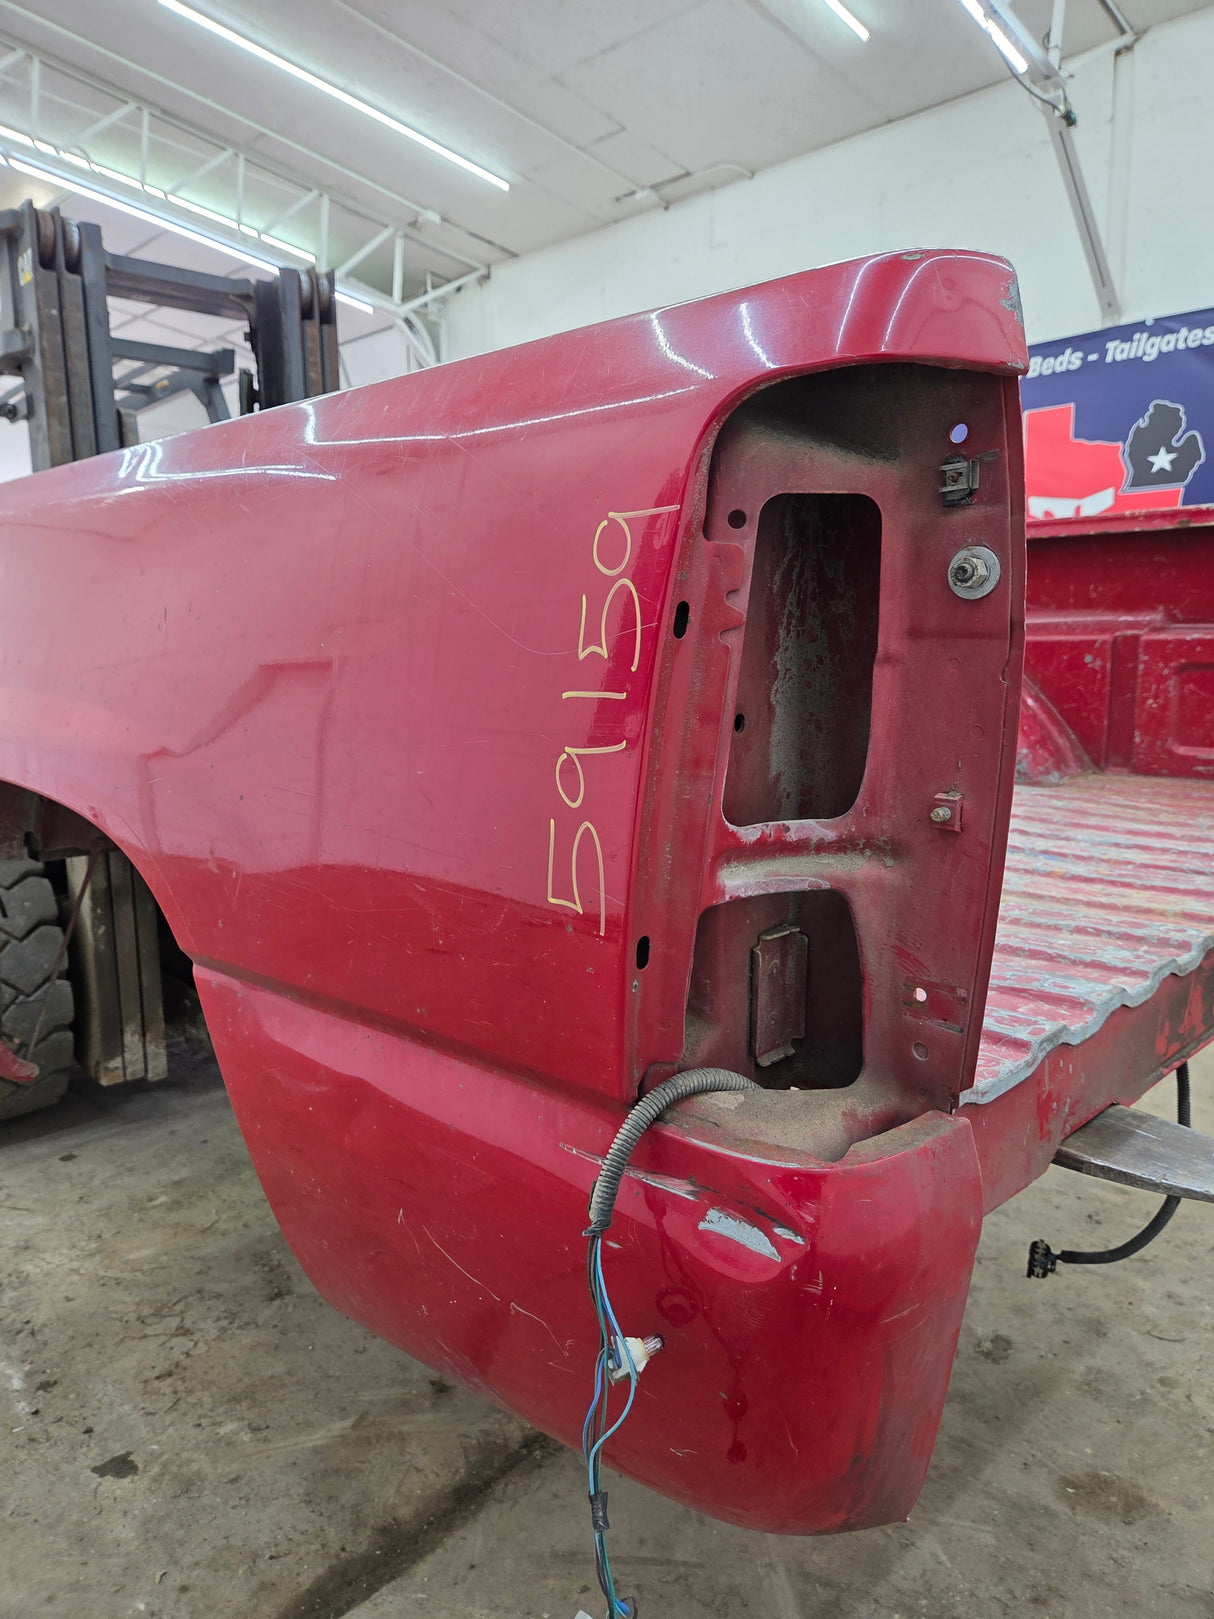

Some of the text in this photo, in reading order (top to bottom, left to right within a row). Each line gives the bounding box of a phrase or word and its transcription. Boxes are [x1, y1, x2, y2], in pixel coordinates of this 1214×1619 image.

[1026, 347, 1084, 379] Beds
[1105, 326, 1214, 363] Tailgates
[548, 504, 680, 936] 59159
